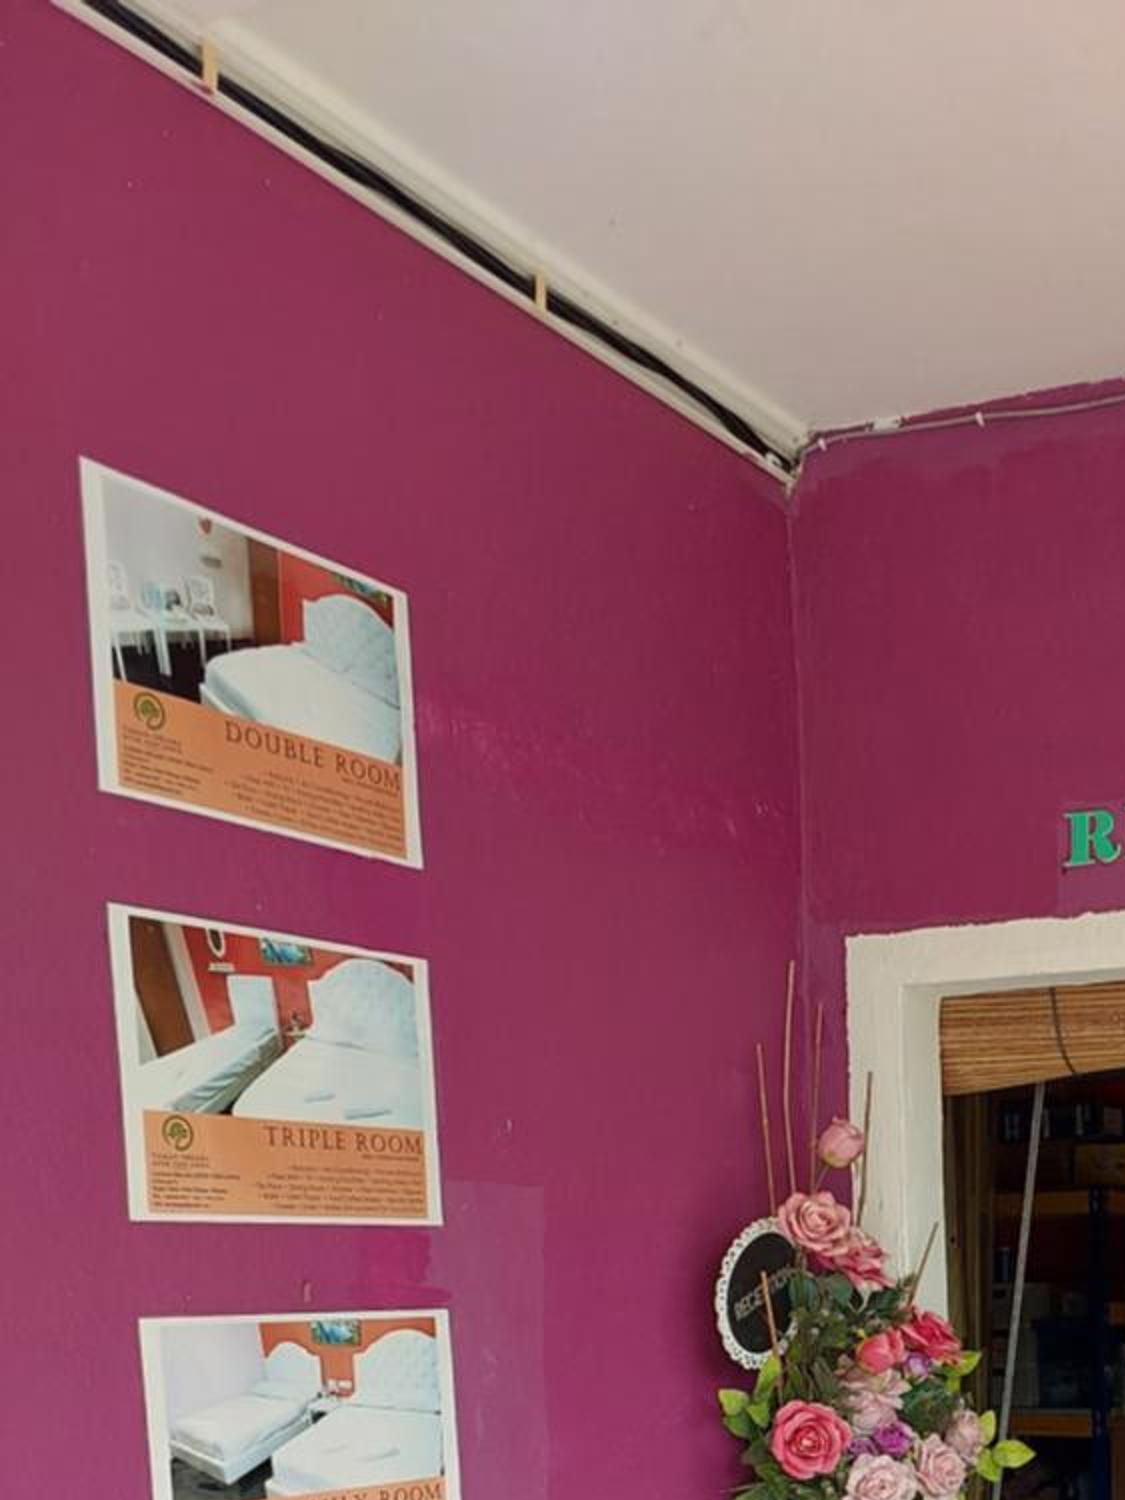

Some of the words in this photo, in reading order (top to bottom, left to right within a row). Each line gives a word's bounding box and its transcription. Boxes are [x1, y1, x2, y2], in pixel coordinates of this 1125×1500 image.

[225, 719, 324, 768] DOUBLE
[335, 755, 401, 790] ROOM
[264, 1125, 346, 1151] TRIPLE
[356, 1133, 423, 1155] ROOM
